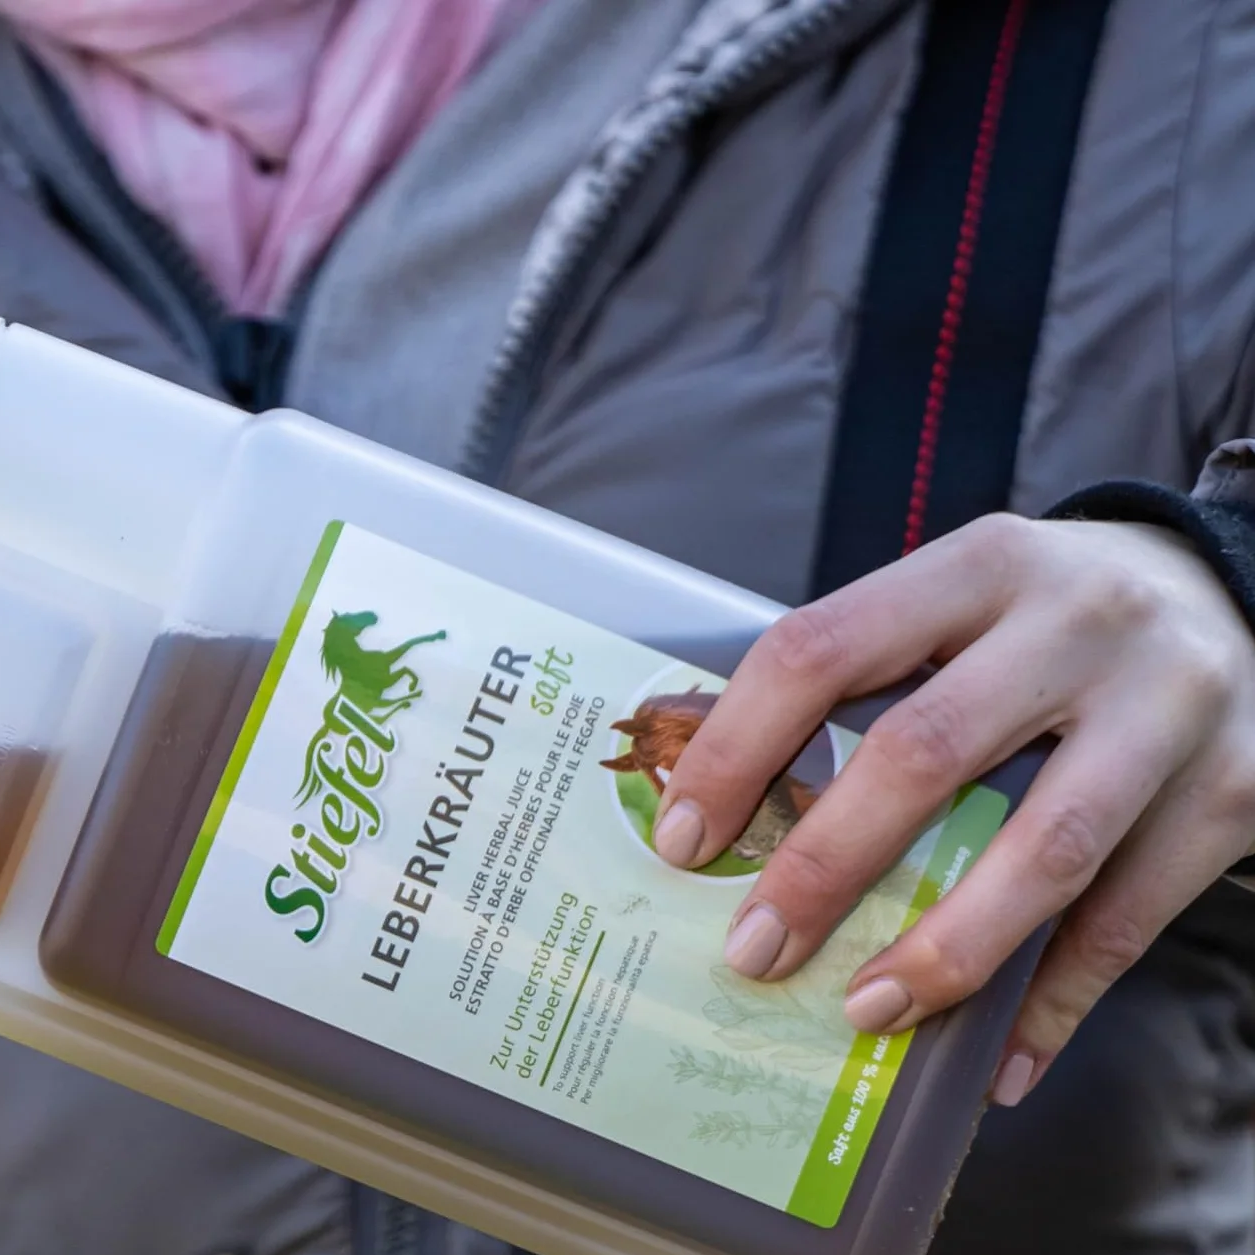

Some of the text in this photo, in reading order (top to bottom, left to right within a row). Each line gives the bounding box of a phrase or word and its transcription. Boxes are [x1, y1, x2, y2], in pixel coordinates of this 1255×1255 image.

[530, 645, 573, 716] saft
[573, 696, 605, 755] FEGATO
[554, 773, 574, 802] PER
[566, 759, 581, 772] IL
[265, 702, 394, 943] Stiefel
[362, 646, 531, 991] LEBERKRÄUTER
[450, 925, 489, 1001] SOLUTION
[480, 912, 496, 926] À
[488, 869, 512, 909] BASE
[535, 750, 561, 793] POUR
[554, 730, 570, 749] LE
[562, 694, 585, 728] FOIE
[464, 767, 533, 913] LIVER HERBAL JUICE
[520, 803, 561, 883] OFFICINALI
[466, 941, 504, 1015] ESTRATTO
[490, 892, 578, 1070] Zur Unterstützung
[517, 905, 598, 1079] der Leberfunktion
[595, 987, 617, 1027] fonction
[553, 978, 604, 1092] To support liver function
[581, 1089, 592, 1105] Per
[590, 1038, 614, 1088] migliorare
[607, 1027, 618, 1038] la
[639, 930, 658, 966] epatica
[591, 1029, 601, 1040] la
[567, 1076, 581, 1099] Pour
[852, 1079, 871, 1106] 100
[862, 1063, 879, 1078] %
[828, 1133, 850, 1166] Saft
[844, 1106, 861, 1133] aus
